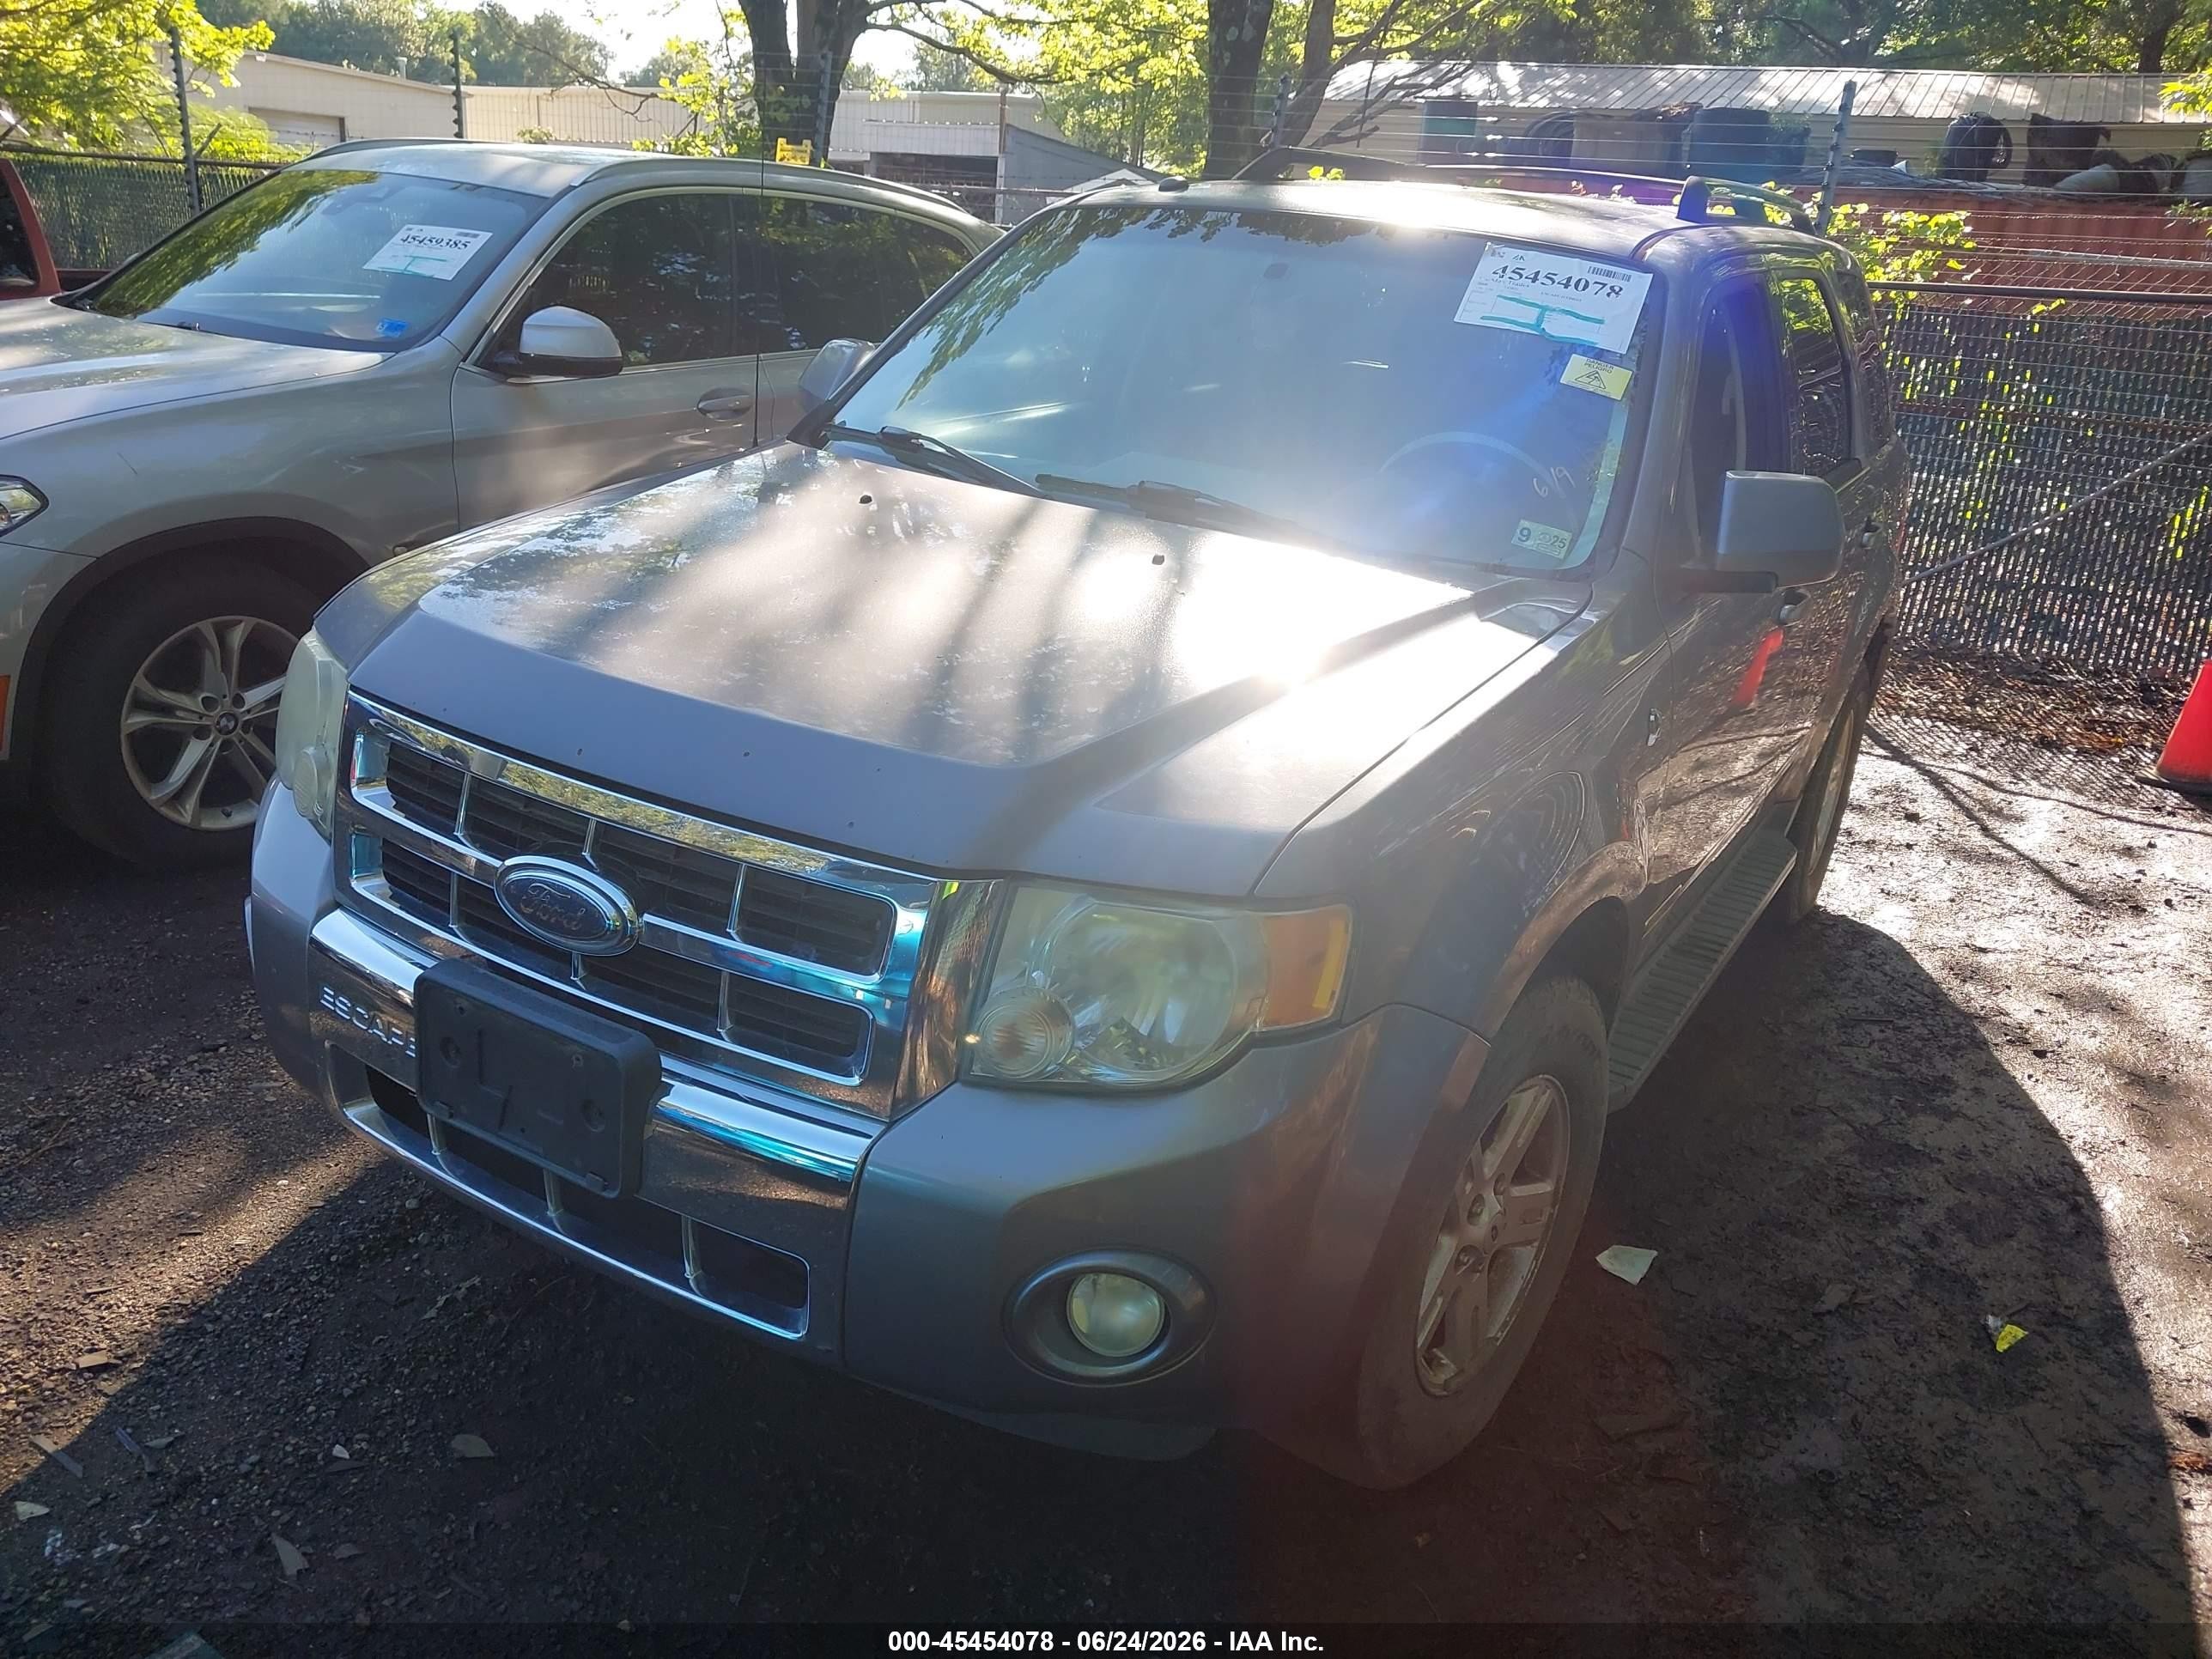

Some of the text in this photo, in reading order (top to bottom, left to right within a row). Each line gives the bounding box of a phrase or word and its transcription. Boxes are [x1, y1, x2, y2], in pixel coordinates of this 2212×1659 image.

[400, 234, 471, 250] 45459385
[1492, 264, 1624, 298] 45454078
[1584, 362, 1613, 374] PELIGRO
[1586, 358, 1614, 370] DANGER
[1518, 527, 1531, 542] 9
[1552, 535, 1567, 549] 25
[520, 883, 582, 930] Ford
